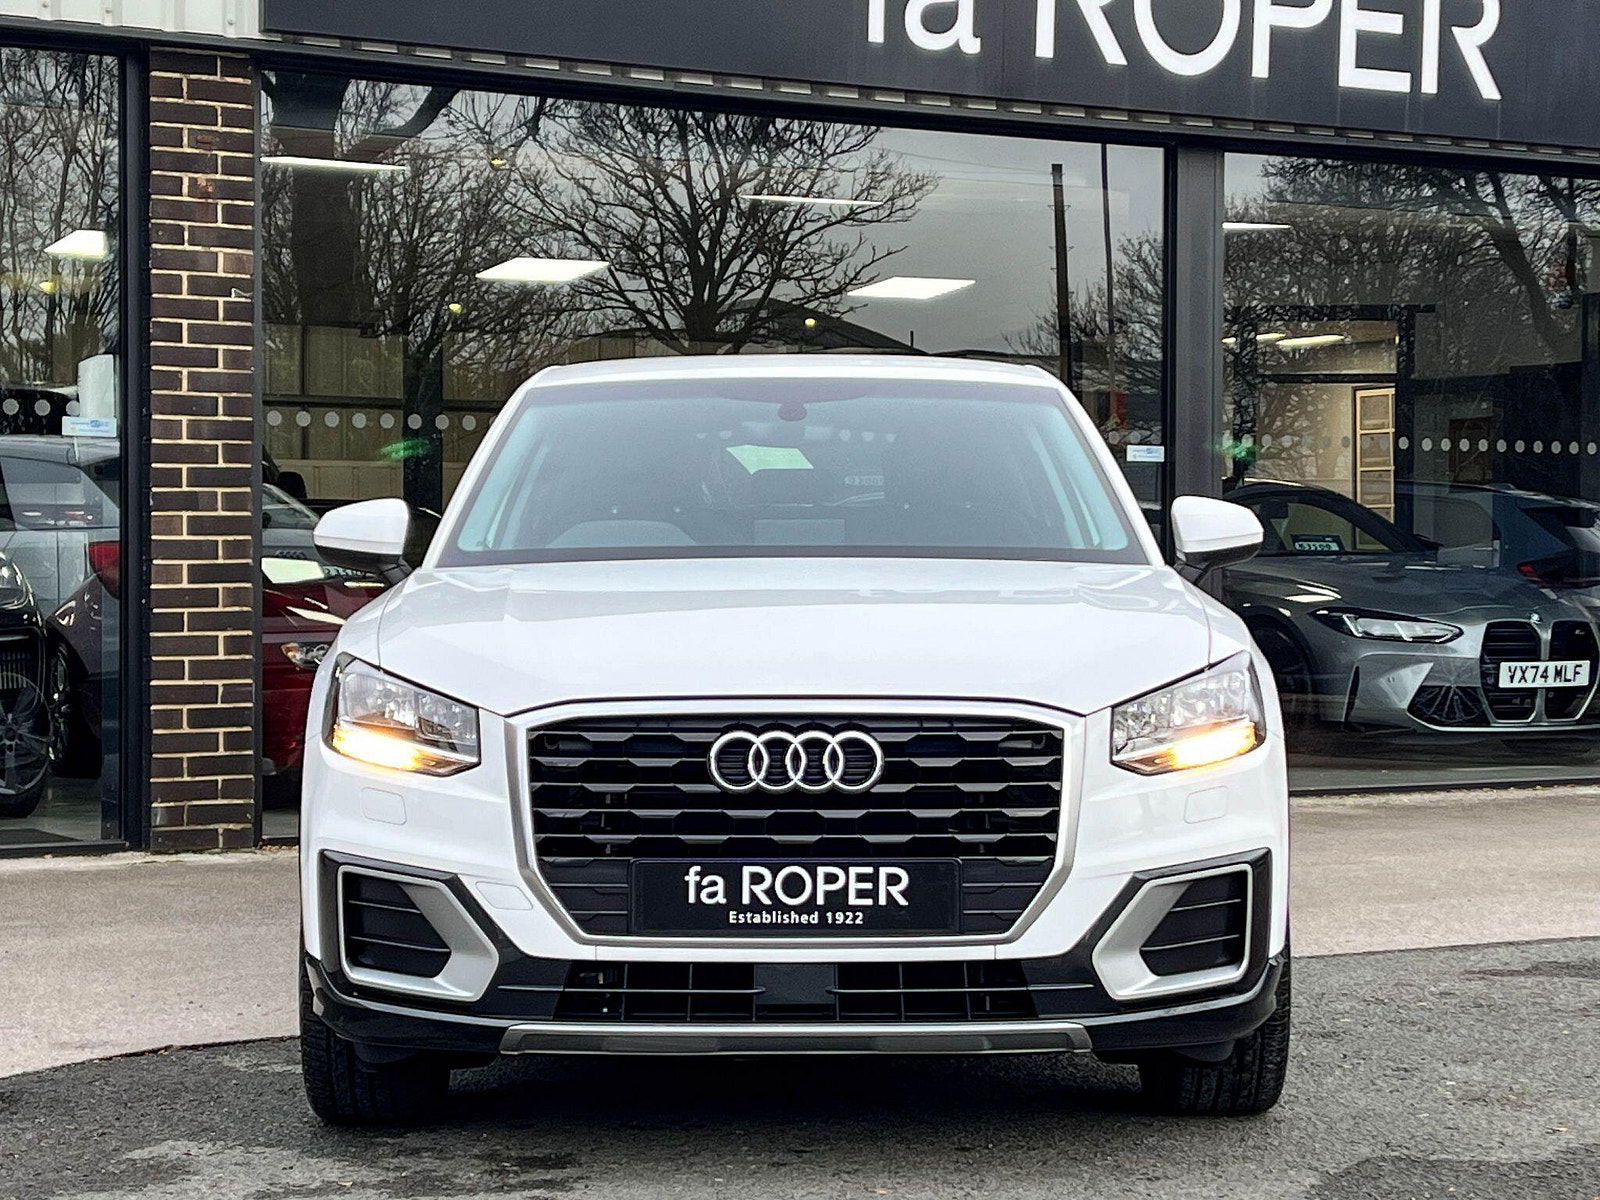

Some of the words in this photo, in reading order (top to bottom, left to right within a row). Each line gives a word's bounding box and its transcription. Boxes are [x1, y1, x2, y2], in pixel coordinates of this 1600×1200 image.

[1553, 663, 1583, 683] MLF
[684, 865, 727, 905] fa
[741, 865, 910, 906] ROPER
[729, 911, 819, 925] Established
[826, 911, 864, 925] 1922
